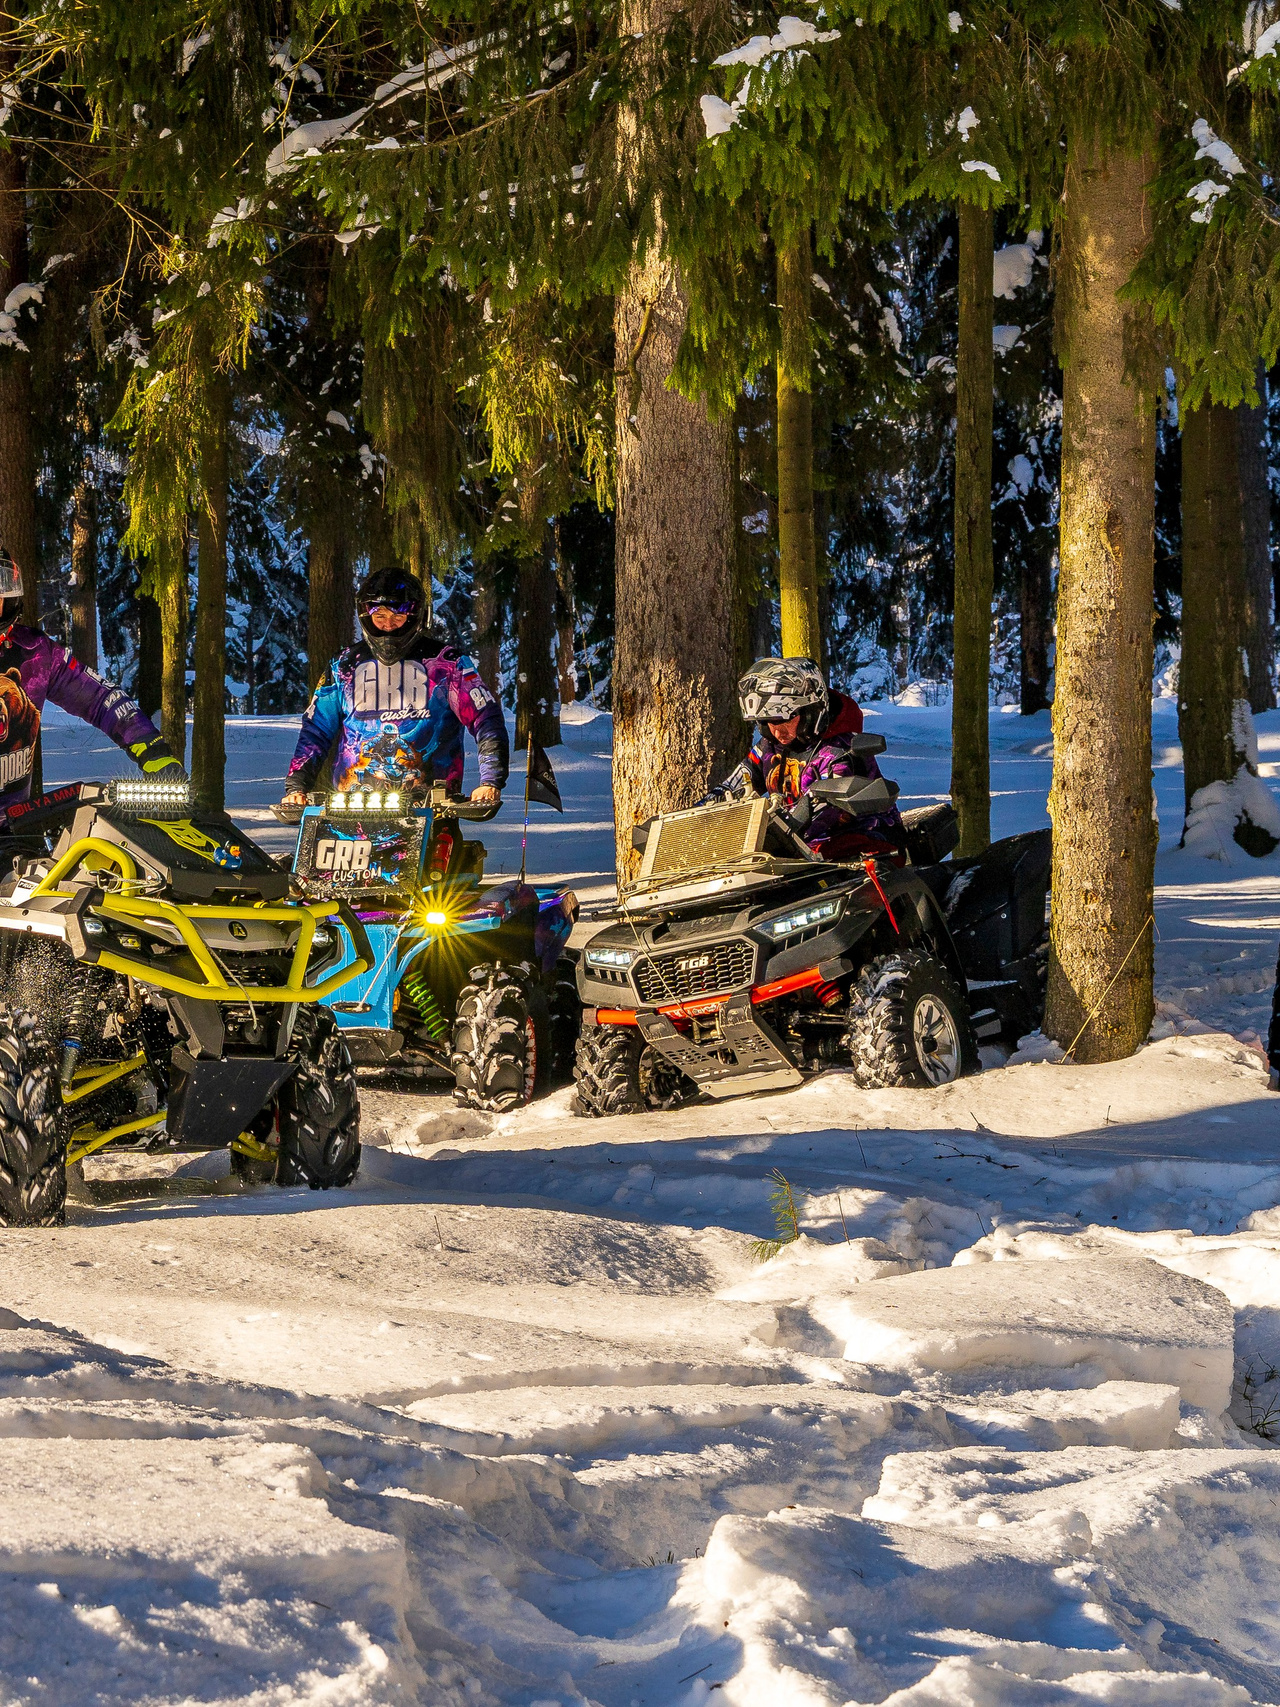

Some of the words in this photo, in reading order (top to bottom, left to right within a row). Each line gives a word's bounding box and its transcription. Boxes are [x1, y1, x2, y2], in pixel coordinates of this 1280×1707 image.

[354, 659, 429, 712] GRB
[379, 703, 431, 722] custom
[316, 839, 372, 871] GRB
[332, 866, 382, 883] CUSTOM
[679, 955, 710, 971] TGB
